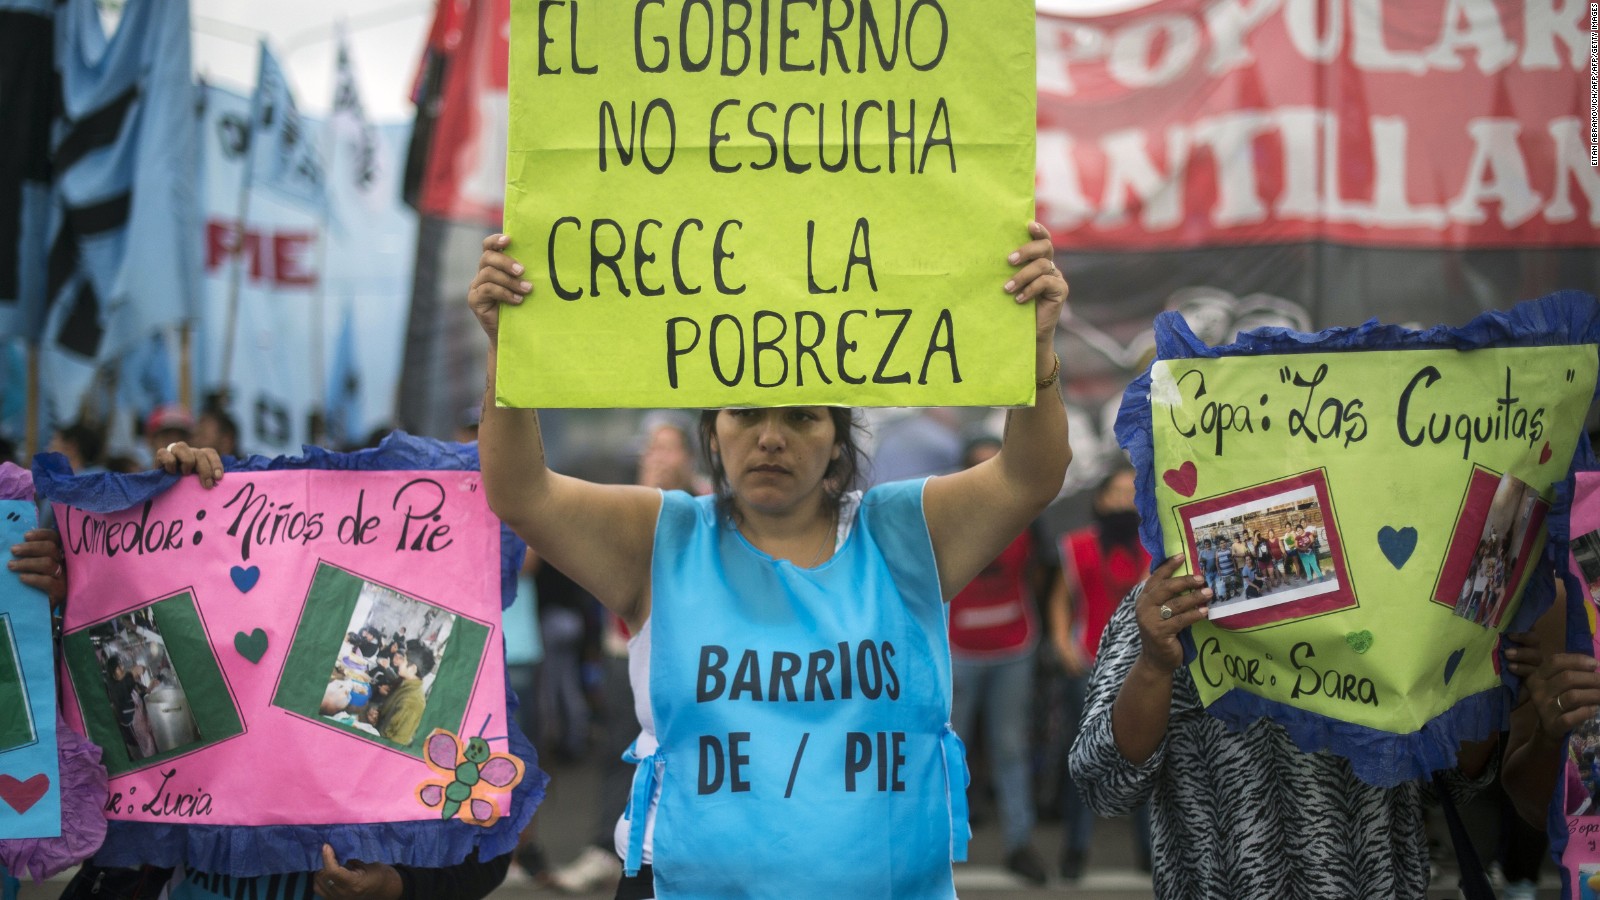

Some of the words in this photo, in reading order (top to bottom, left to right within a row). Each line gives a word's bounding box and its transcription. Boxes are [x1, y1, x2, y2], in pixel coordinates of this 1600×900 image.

[538, 0, 599, 75] EL
[634, 0, 949, 76] GOBIERNO
[599, 98, 676, 174] NO
[709, 98, 957, 174] ESCUCHA
[205, 217, 317, 288] PIE
[548, 216, 747, 300] CRECE
[806, 217, 878, 294] LA
[666, 309, 963, 389] POBREZA
[222, 482, 324, 561] Niños
[337, 489, 381, 546] de
[696, 639, 900, 703] BARRIOS
[142, 768, 213, 817] Lucia
[697, 732, 751, 796] DE
[845, 732, 906, 793] PIE
